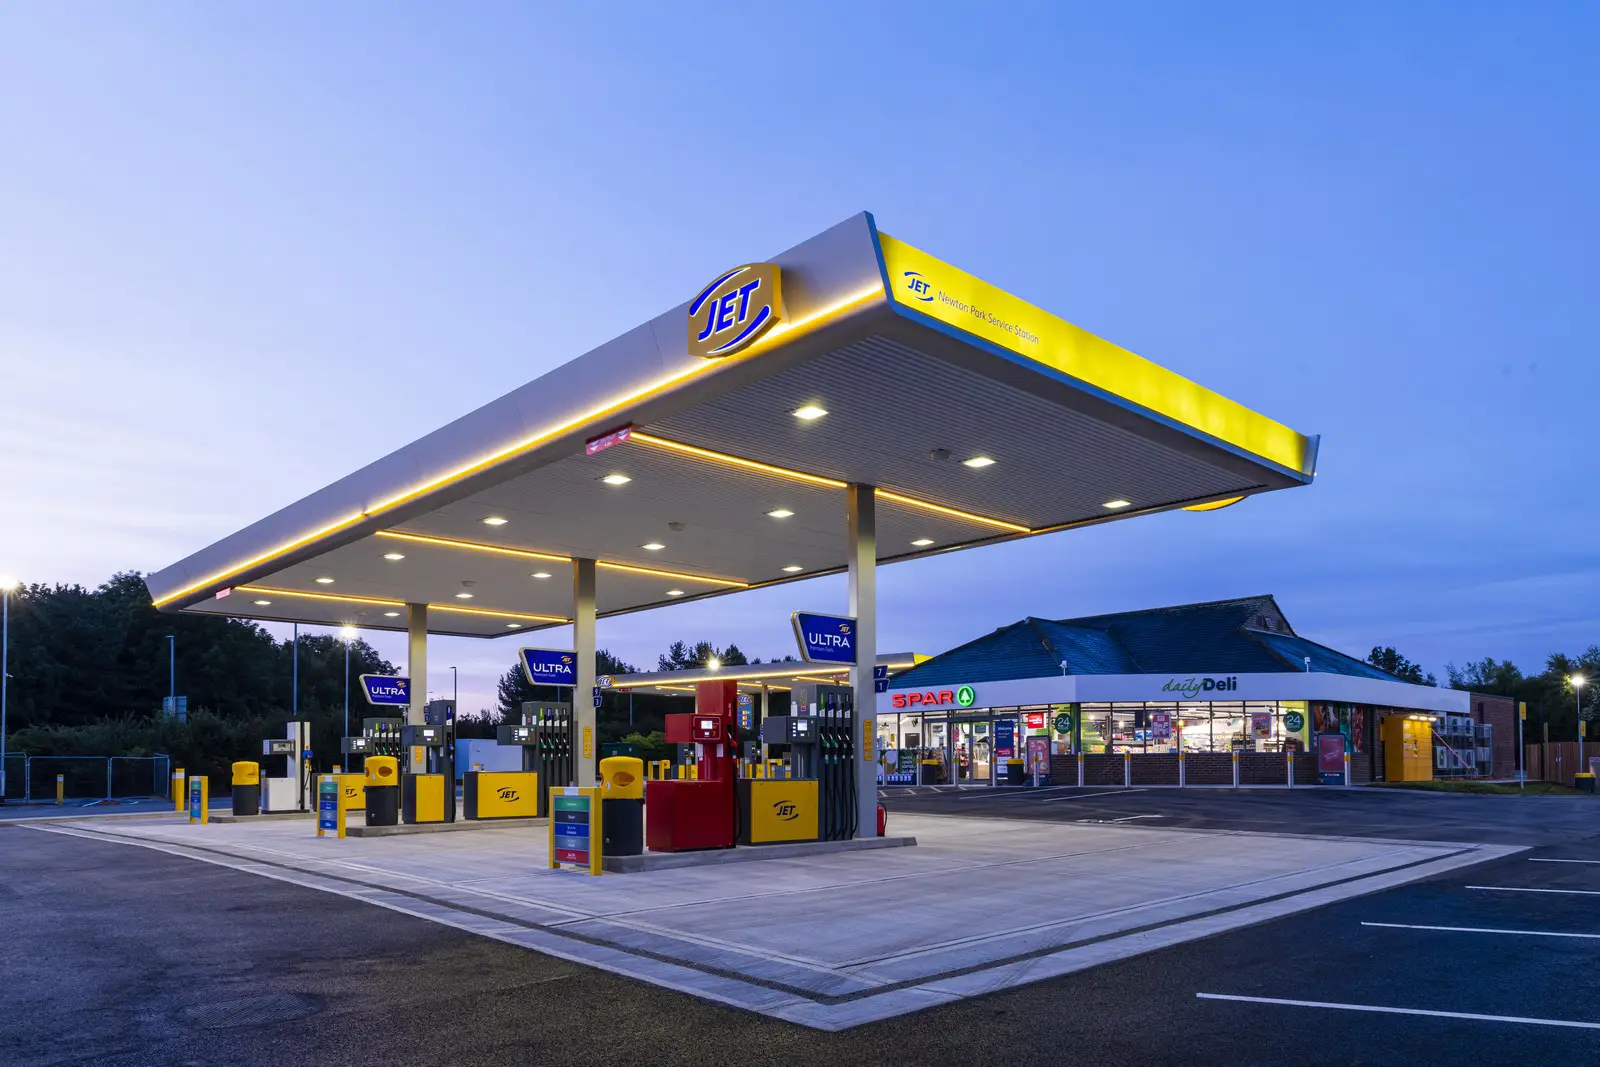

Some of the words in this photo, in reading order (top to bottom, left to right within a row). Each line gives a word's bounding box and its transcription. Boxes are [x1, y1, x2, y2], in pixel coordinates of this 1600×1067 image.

[907, 277, 932, 296] JET
[697, 278, 762, 342] JET
[938, 291, 970, 313] Newton
[970, 305, 988, 320] Park
[988, 311, 1014, 333] Service
[1014, 324, 1040, 345] Station
[809, 632, 851, 648] ULTRA
[533, 663, 572, 674] ULTRA
[877, 668, 883, 677] 7
[371, 686, 406, 696] ULTRA
[878, 682, 883, 691] 1
[1161, 677, 1207, 699] daily
[1202, 677, 1237, 692] Deli
[892, 690, 953, 708] SPAR
[1057, 717, 1070, 727] 24
[1286, 715, 1302, 725] 24
[499, 790, 517, 799] JET
[776, 805, 797, 816] JET
